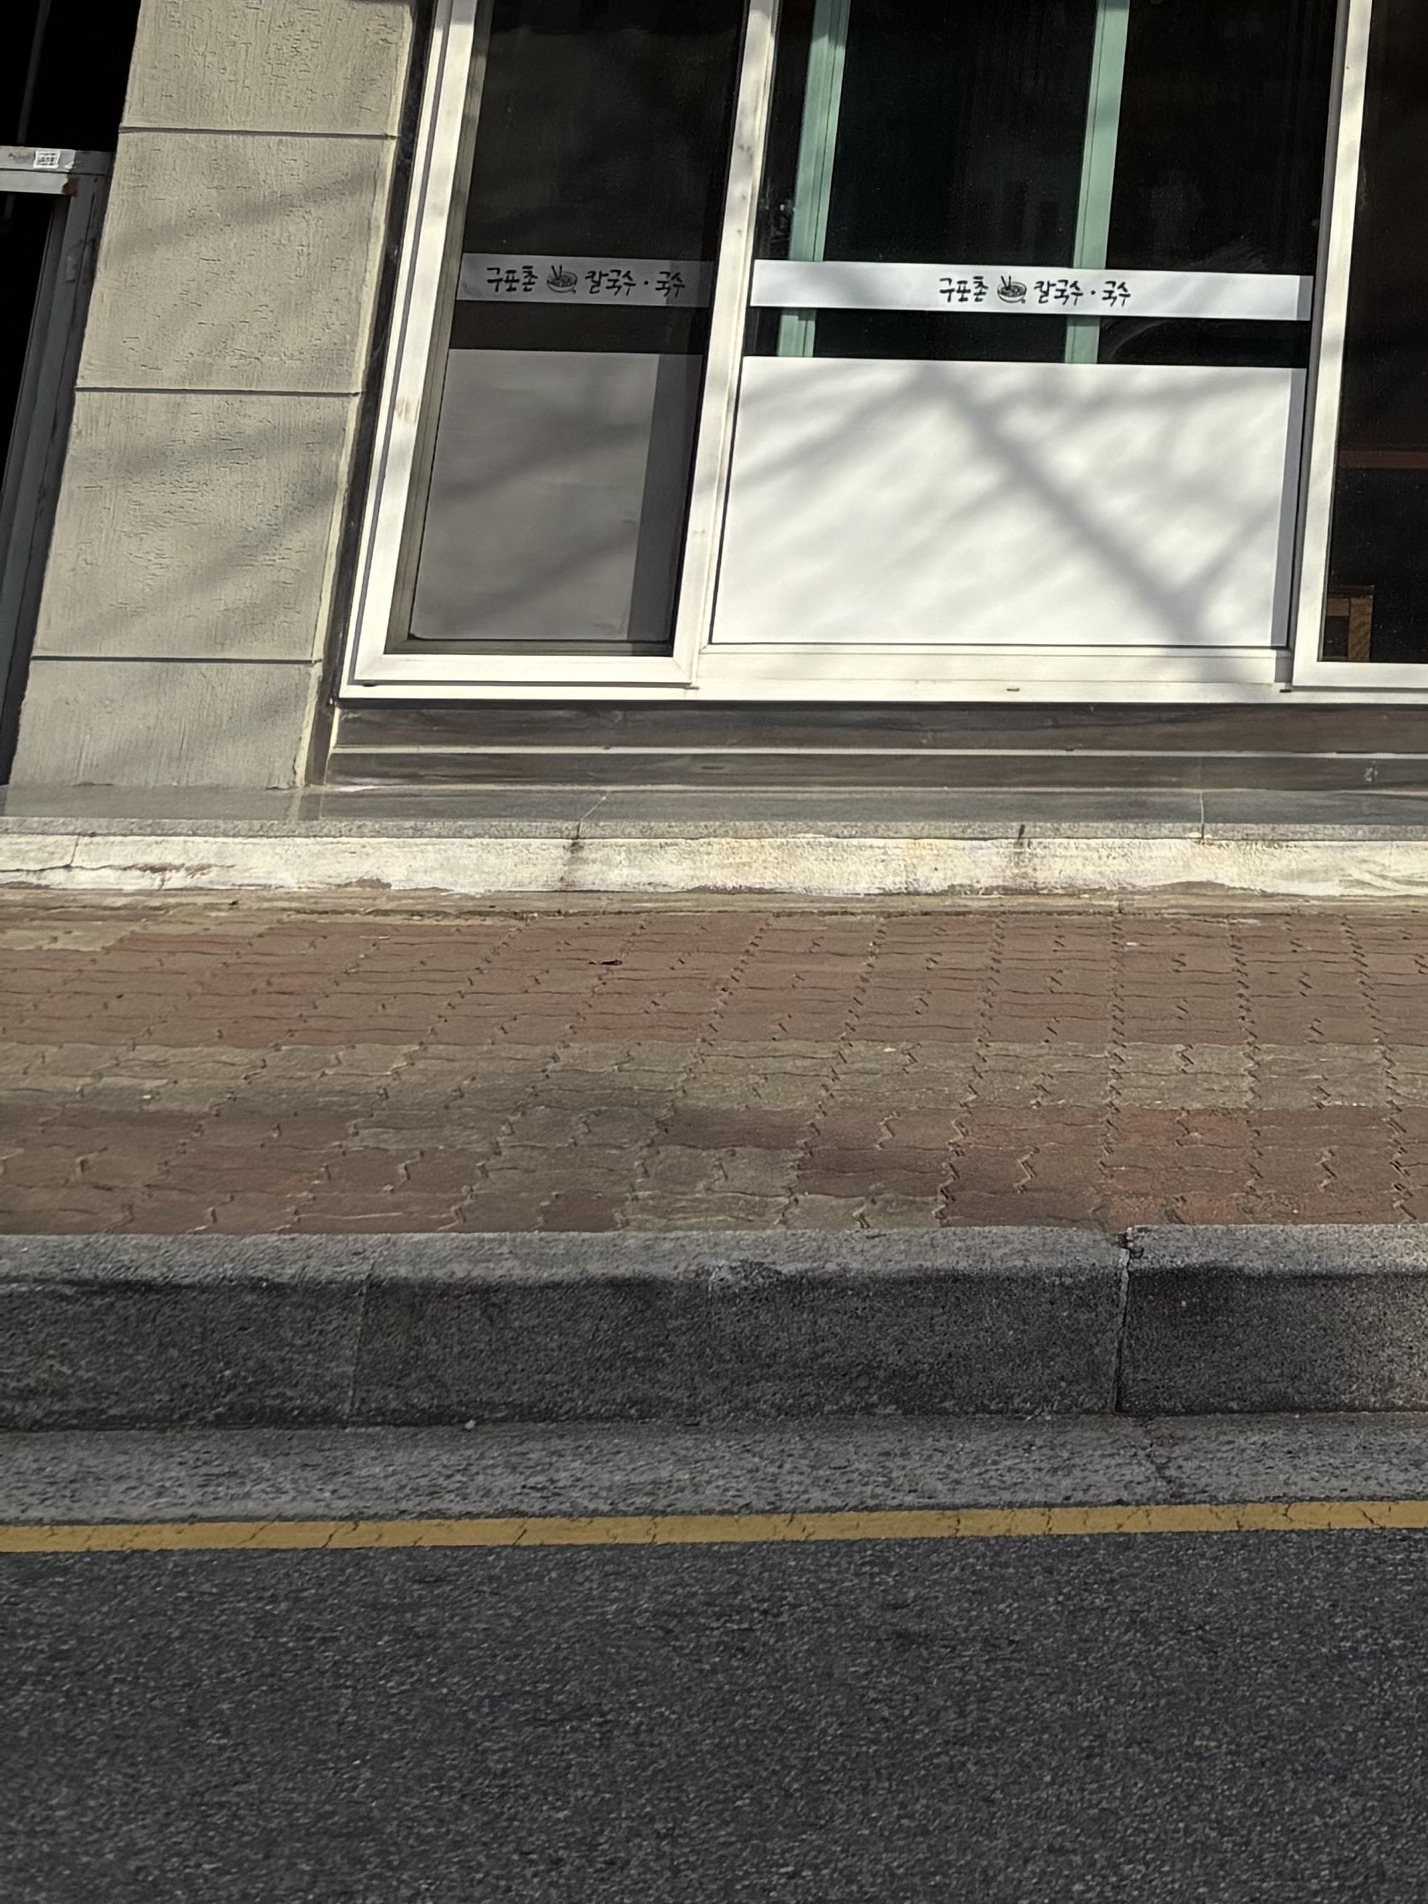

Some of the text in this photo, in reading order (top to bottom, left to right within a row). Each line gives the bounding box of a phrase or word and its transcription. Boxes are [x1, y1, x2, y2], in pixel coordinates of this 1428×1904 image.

[486, 265, 686, 298] 구포촌 칼국수 국수
[939, 275, 1131, 307] 구포촌 칼국수 국수
